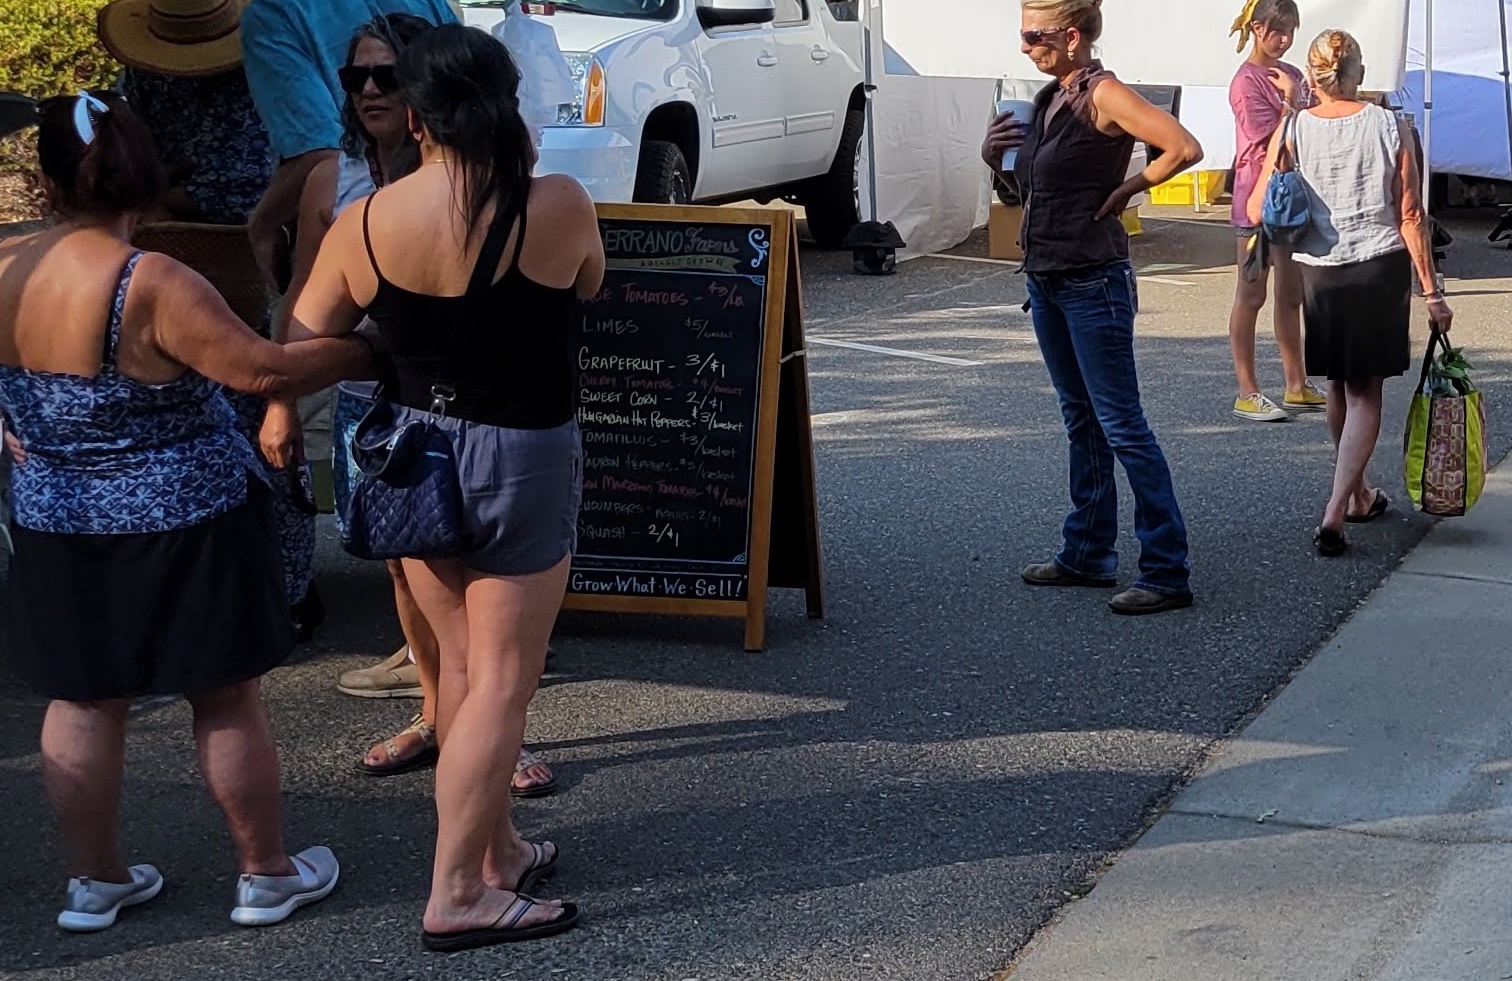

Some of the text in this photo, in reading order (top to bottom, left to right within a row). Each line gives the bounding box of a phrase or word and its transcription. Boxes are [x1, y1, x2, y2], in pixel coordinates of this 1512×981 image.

[602, 224, 740, 254] ERRANO Farms
[621, 282, 689, 307] TOMATOES
[582, 315, 640, 335] LIMES
[578, 346, 726, 379] GRAPEFRUIT 3/$1
[580, 388, 724, 413] SWEET CORN 2/$1
